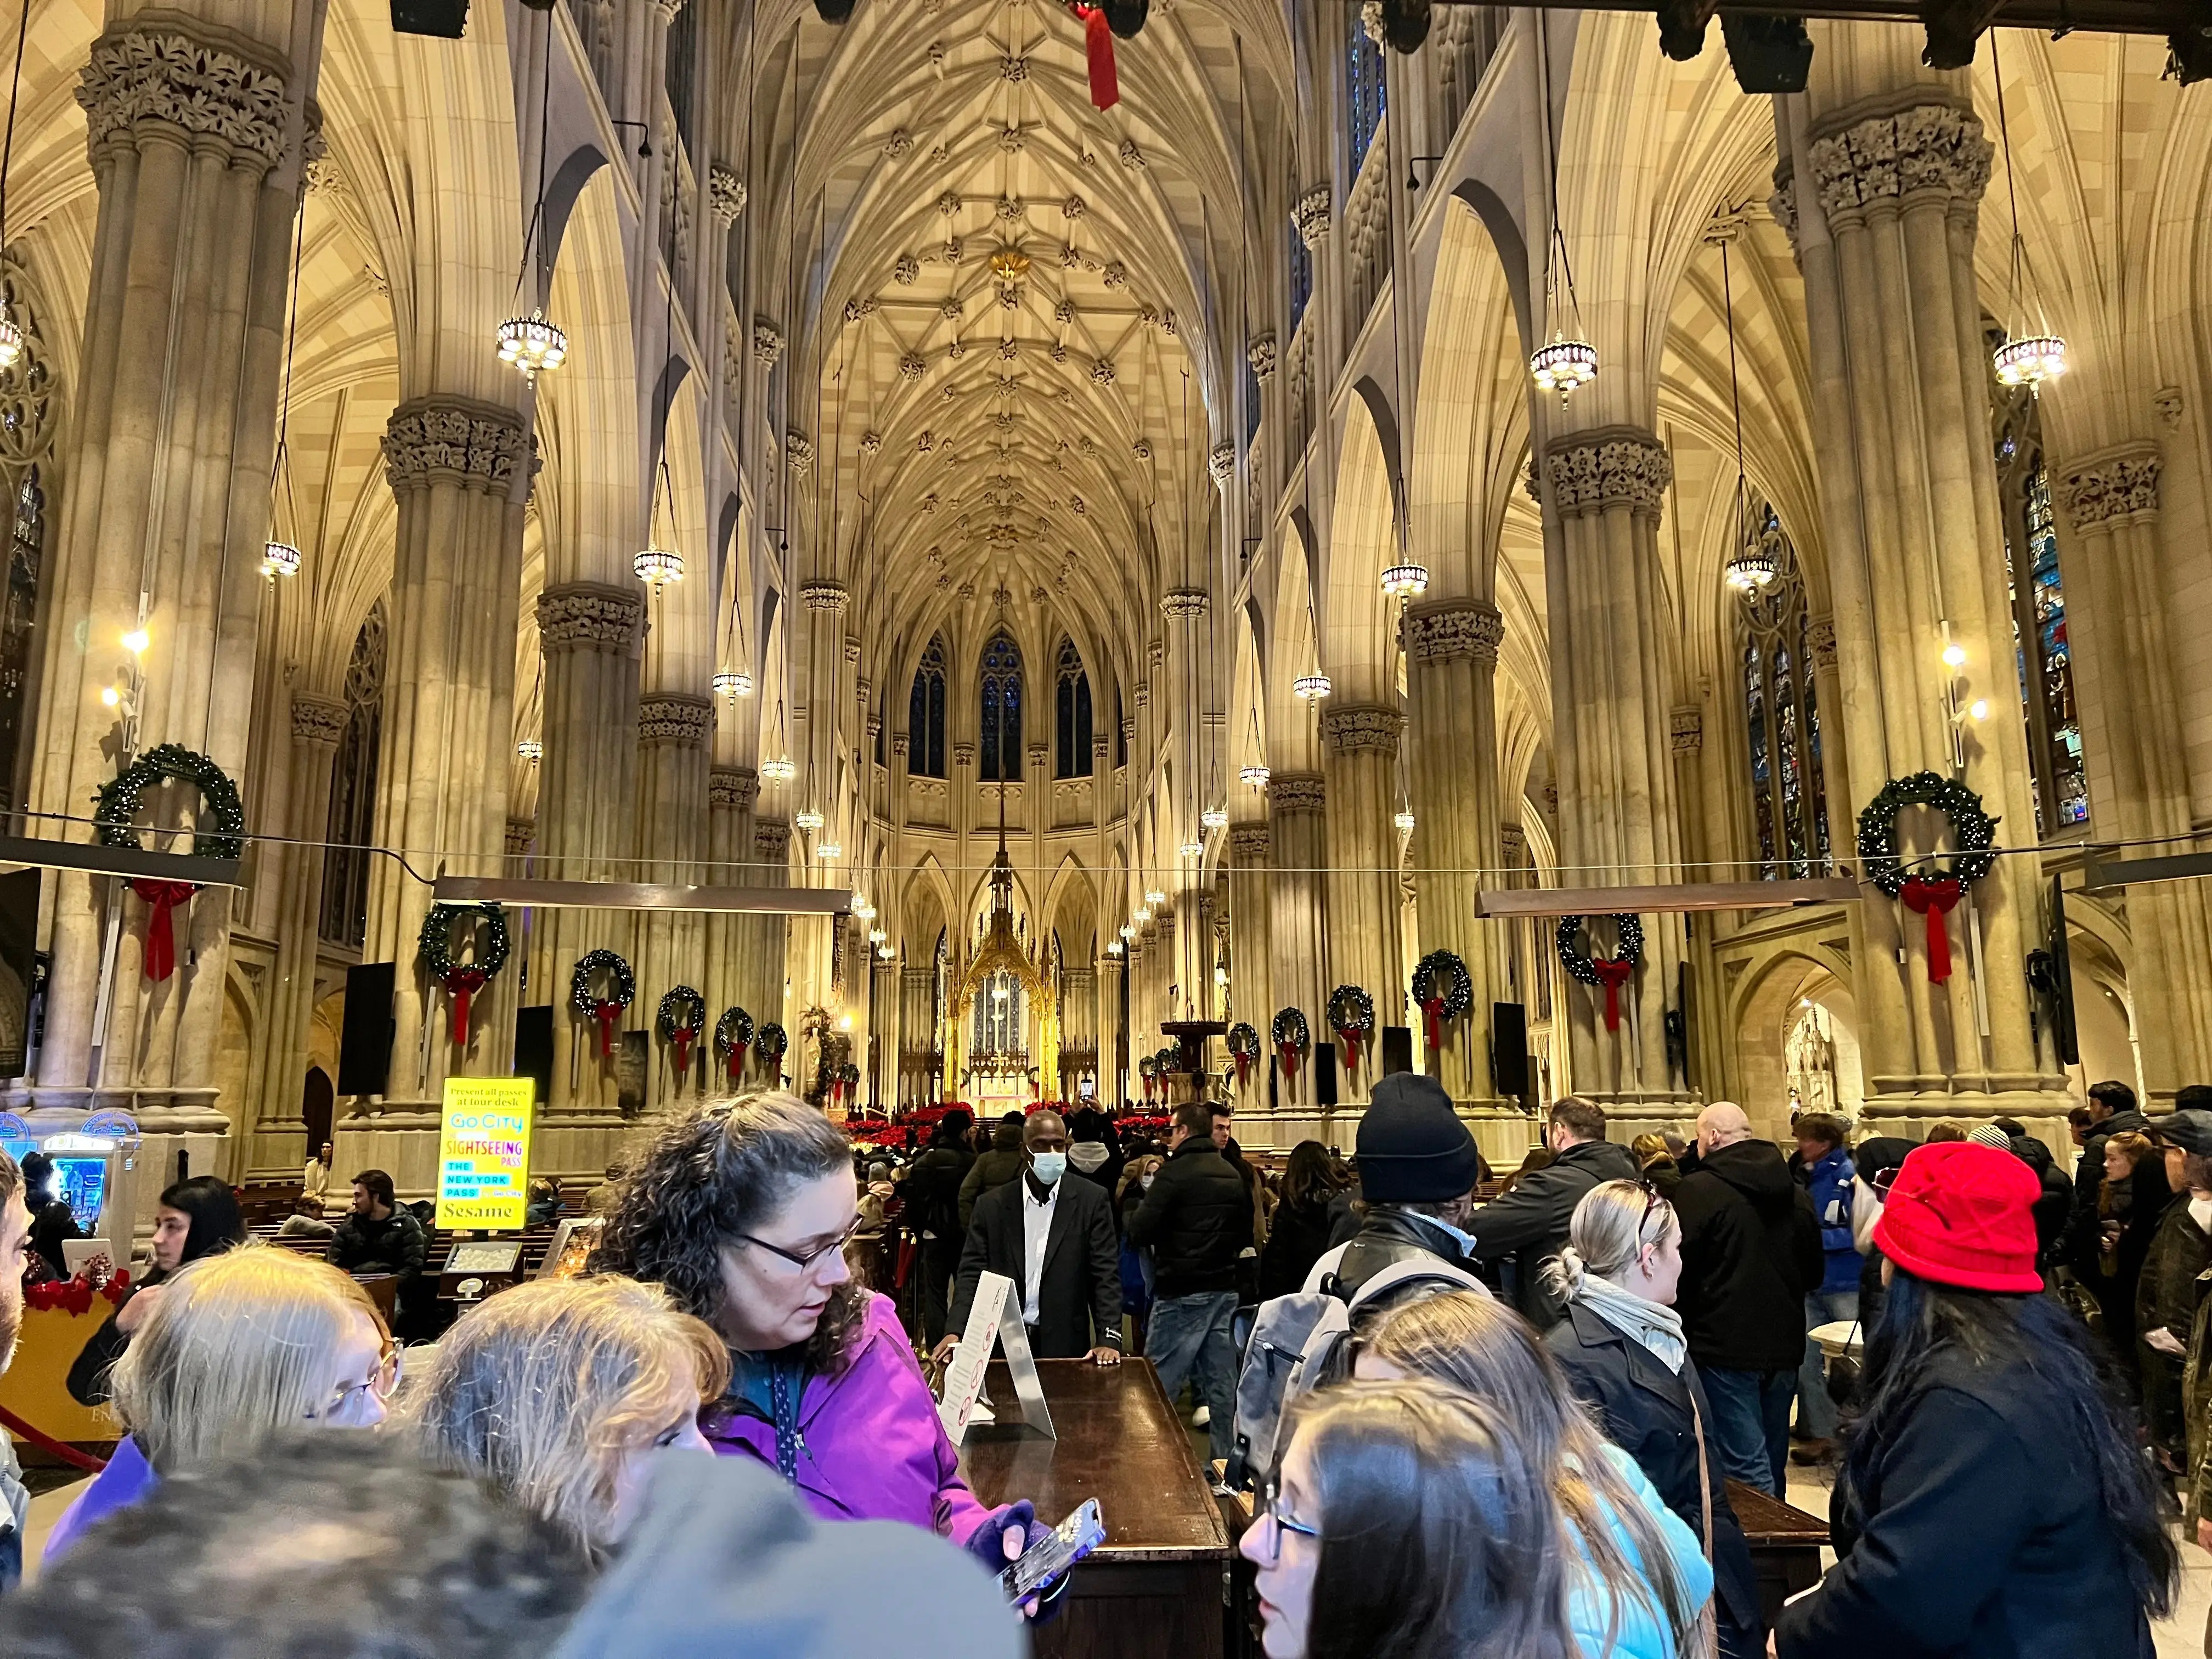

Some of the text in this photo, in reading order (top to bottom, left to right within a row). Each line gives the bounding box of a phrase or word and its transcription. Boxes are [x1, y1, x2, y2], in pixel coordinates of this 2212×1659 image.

[446, 1141, 522, 1155] SIGHTSEEING
[501, 1157, 521, 1167] PASS
[444, 1203, 512, 1218] Sesame
